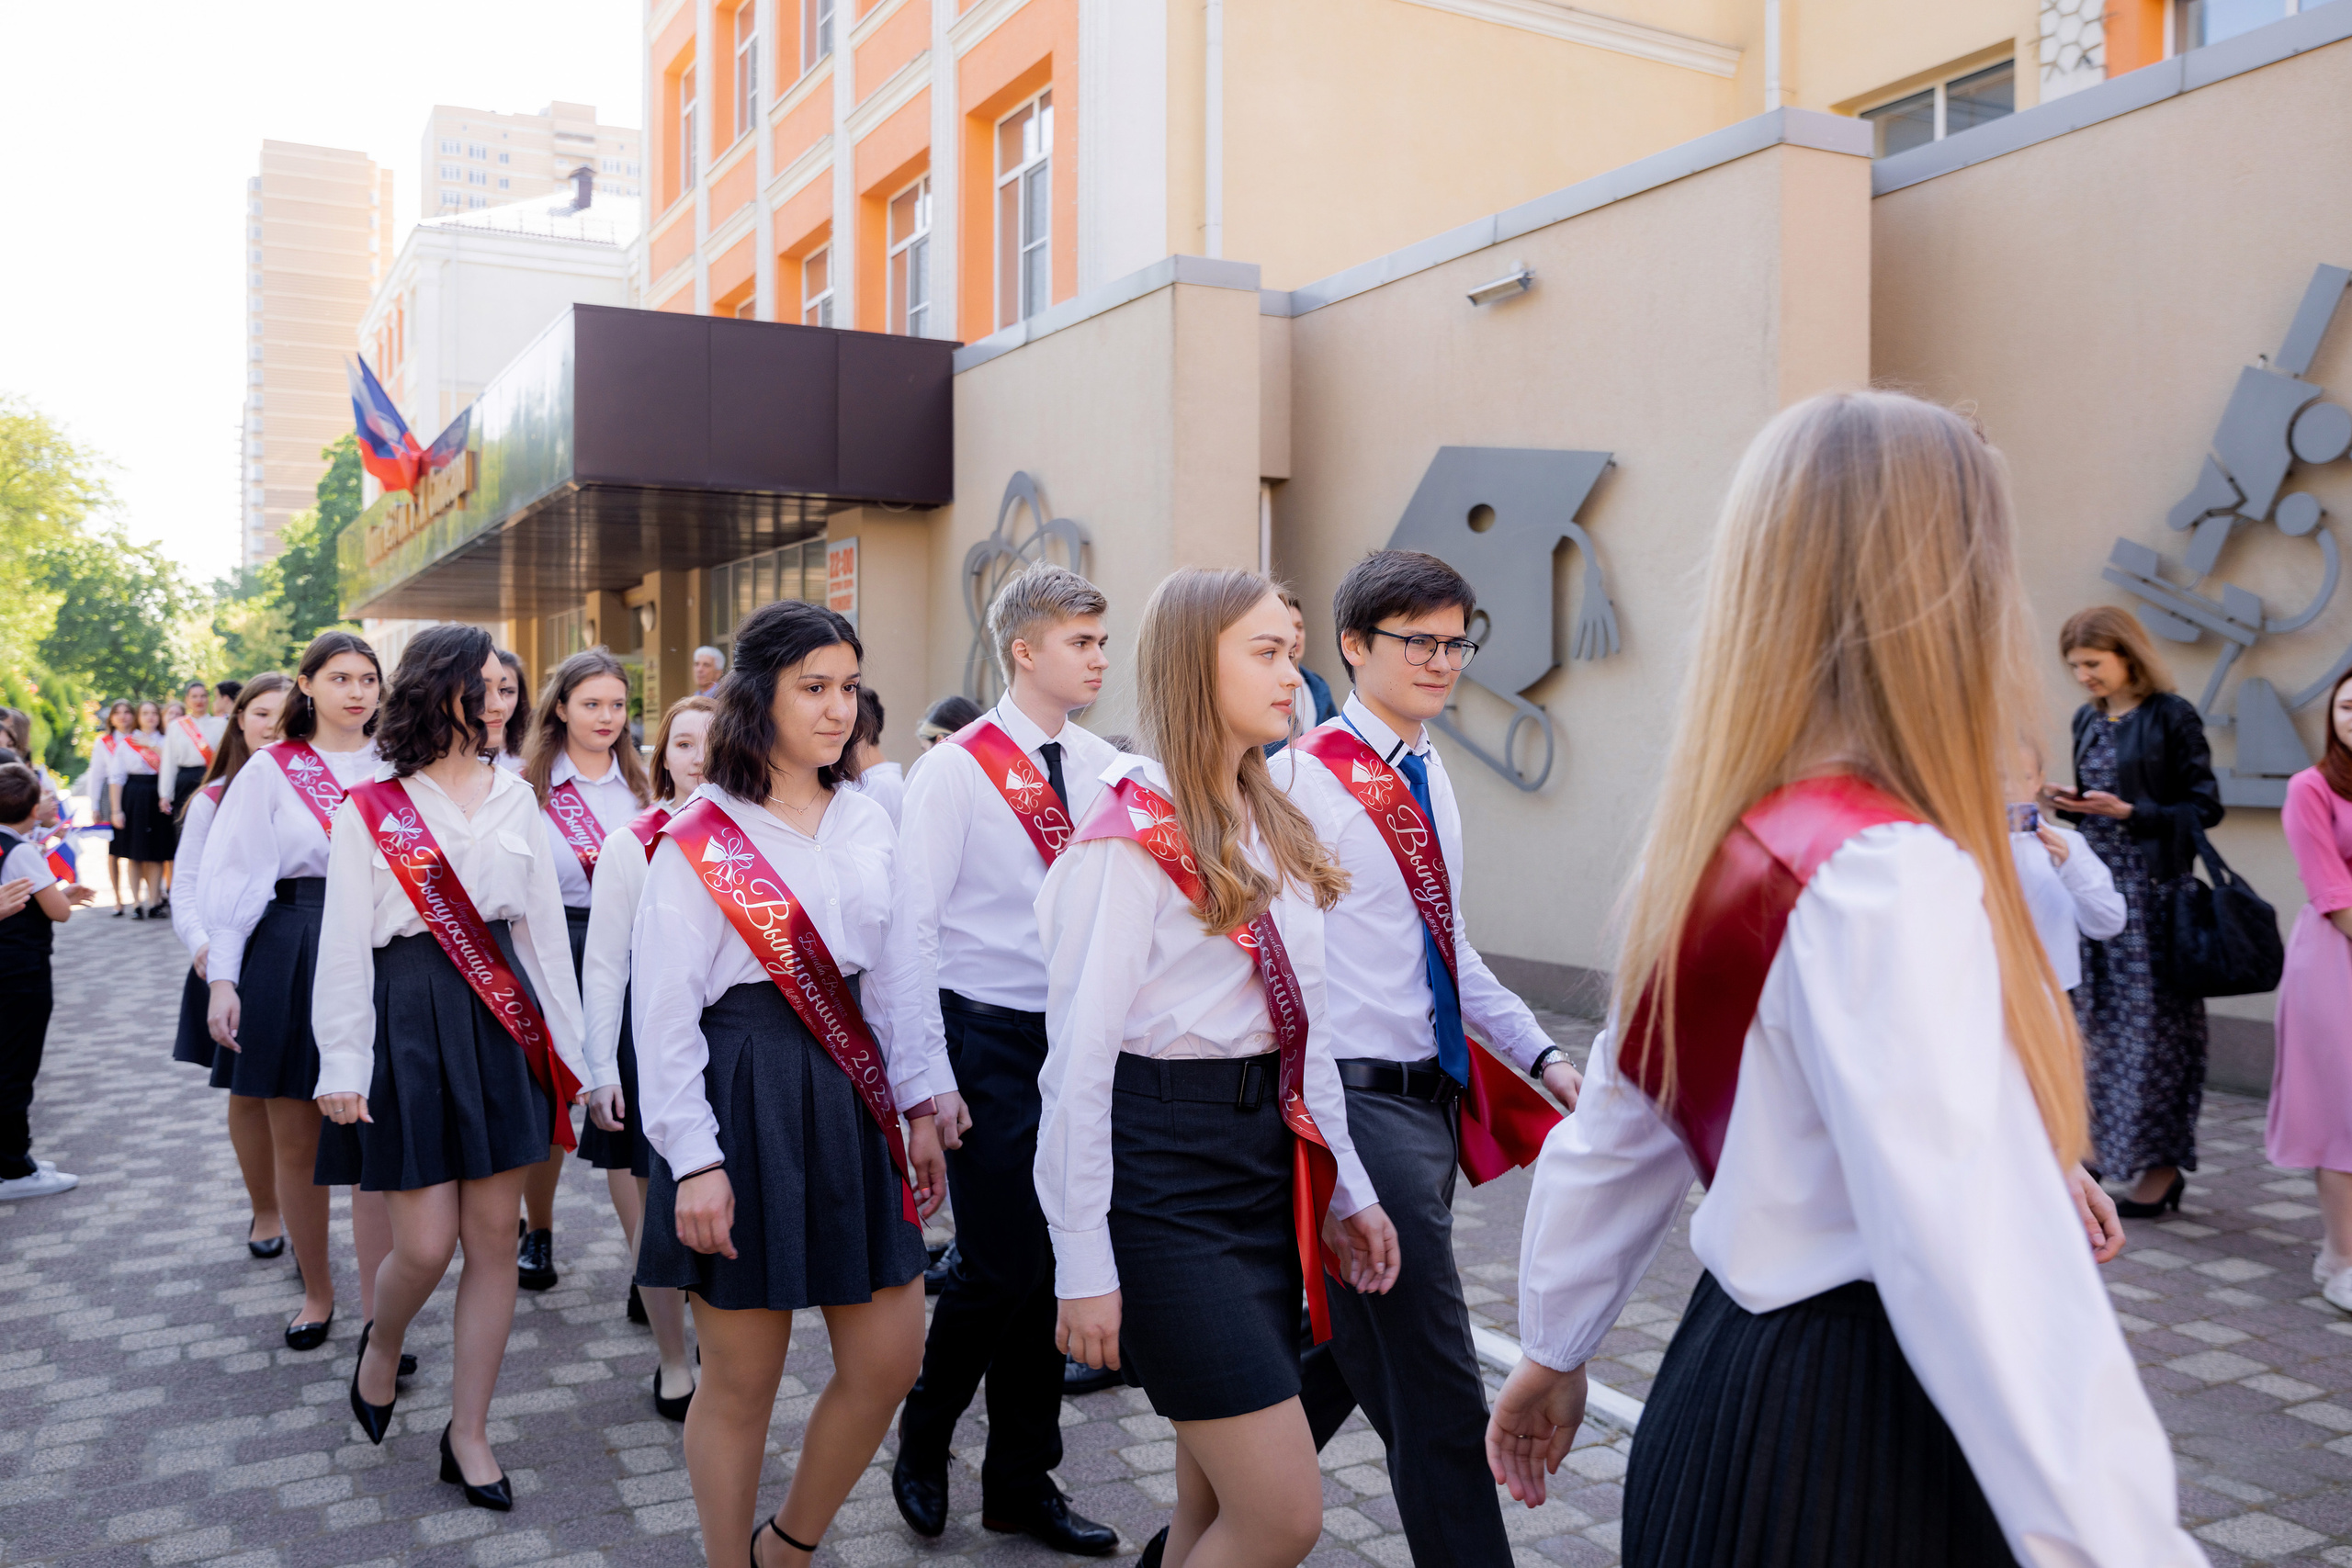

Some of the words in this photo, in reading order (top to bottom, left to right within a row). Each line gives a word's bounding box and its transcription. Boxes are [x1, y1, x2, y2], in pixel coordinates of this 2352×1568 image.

[550, 793, 598, 864] Выпуск
[401, 846, 493, 986] Выпускница
[492, 987, 539, 1044] 2022
[732, 878, 849, 1048] Выпускница
[851, 1050, 890, 1119] 2022
[1281, 962, 1300, 1008] Алина
